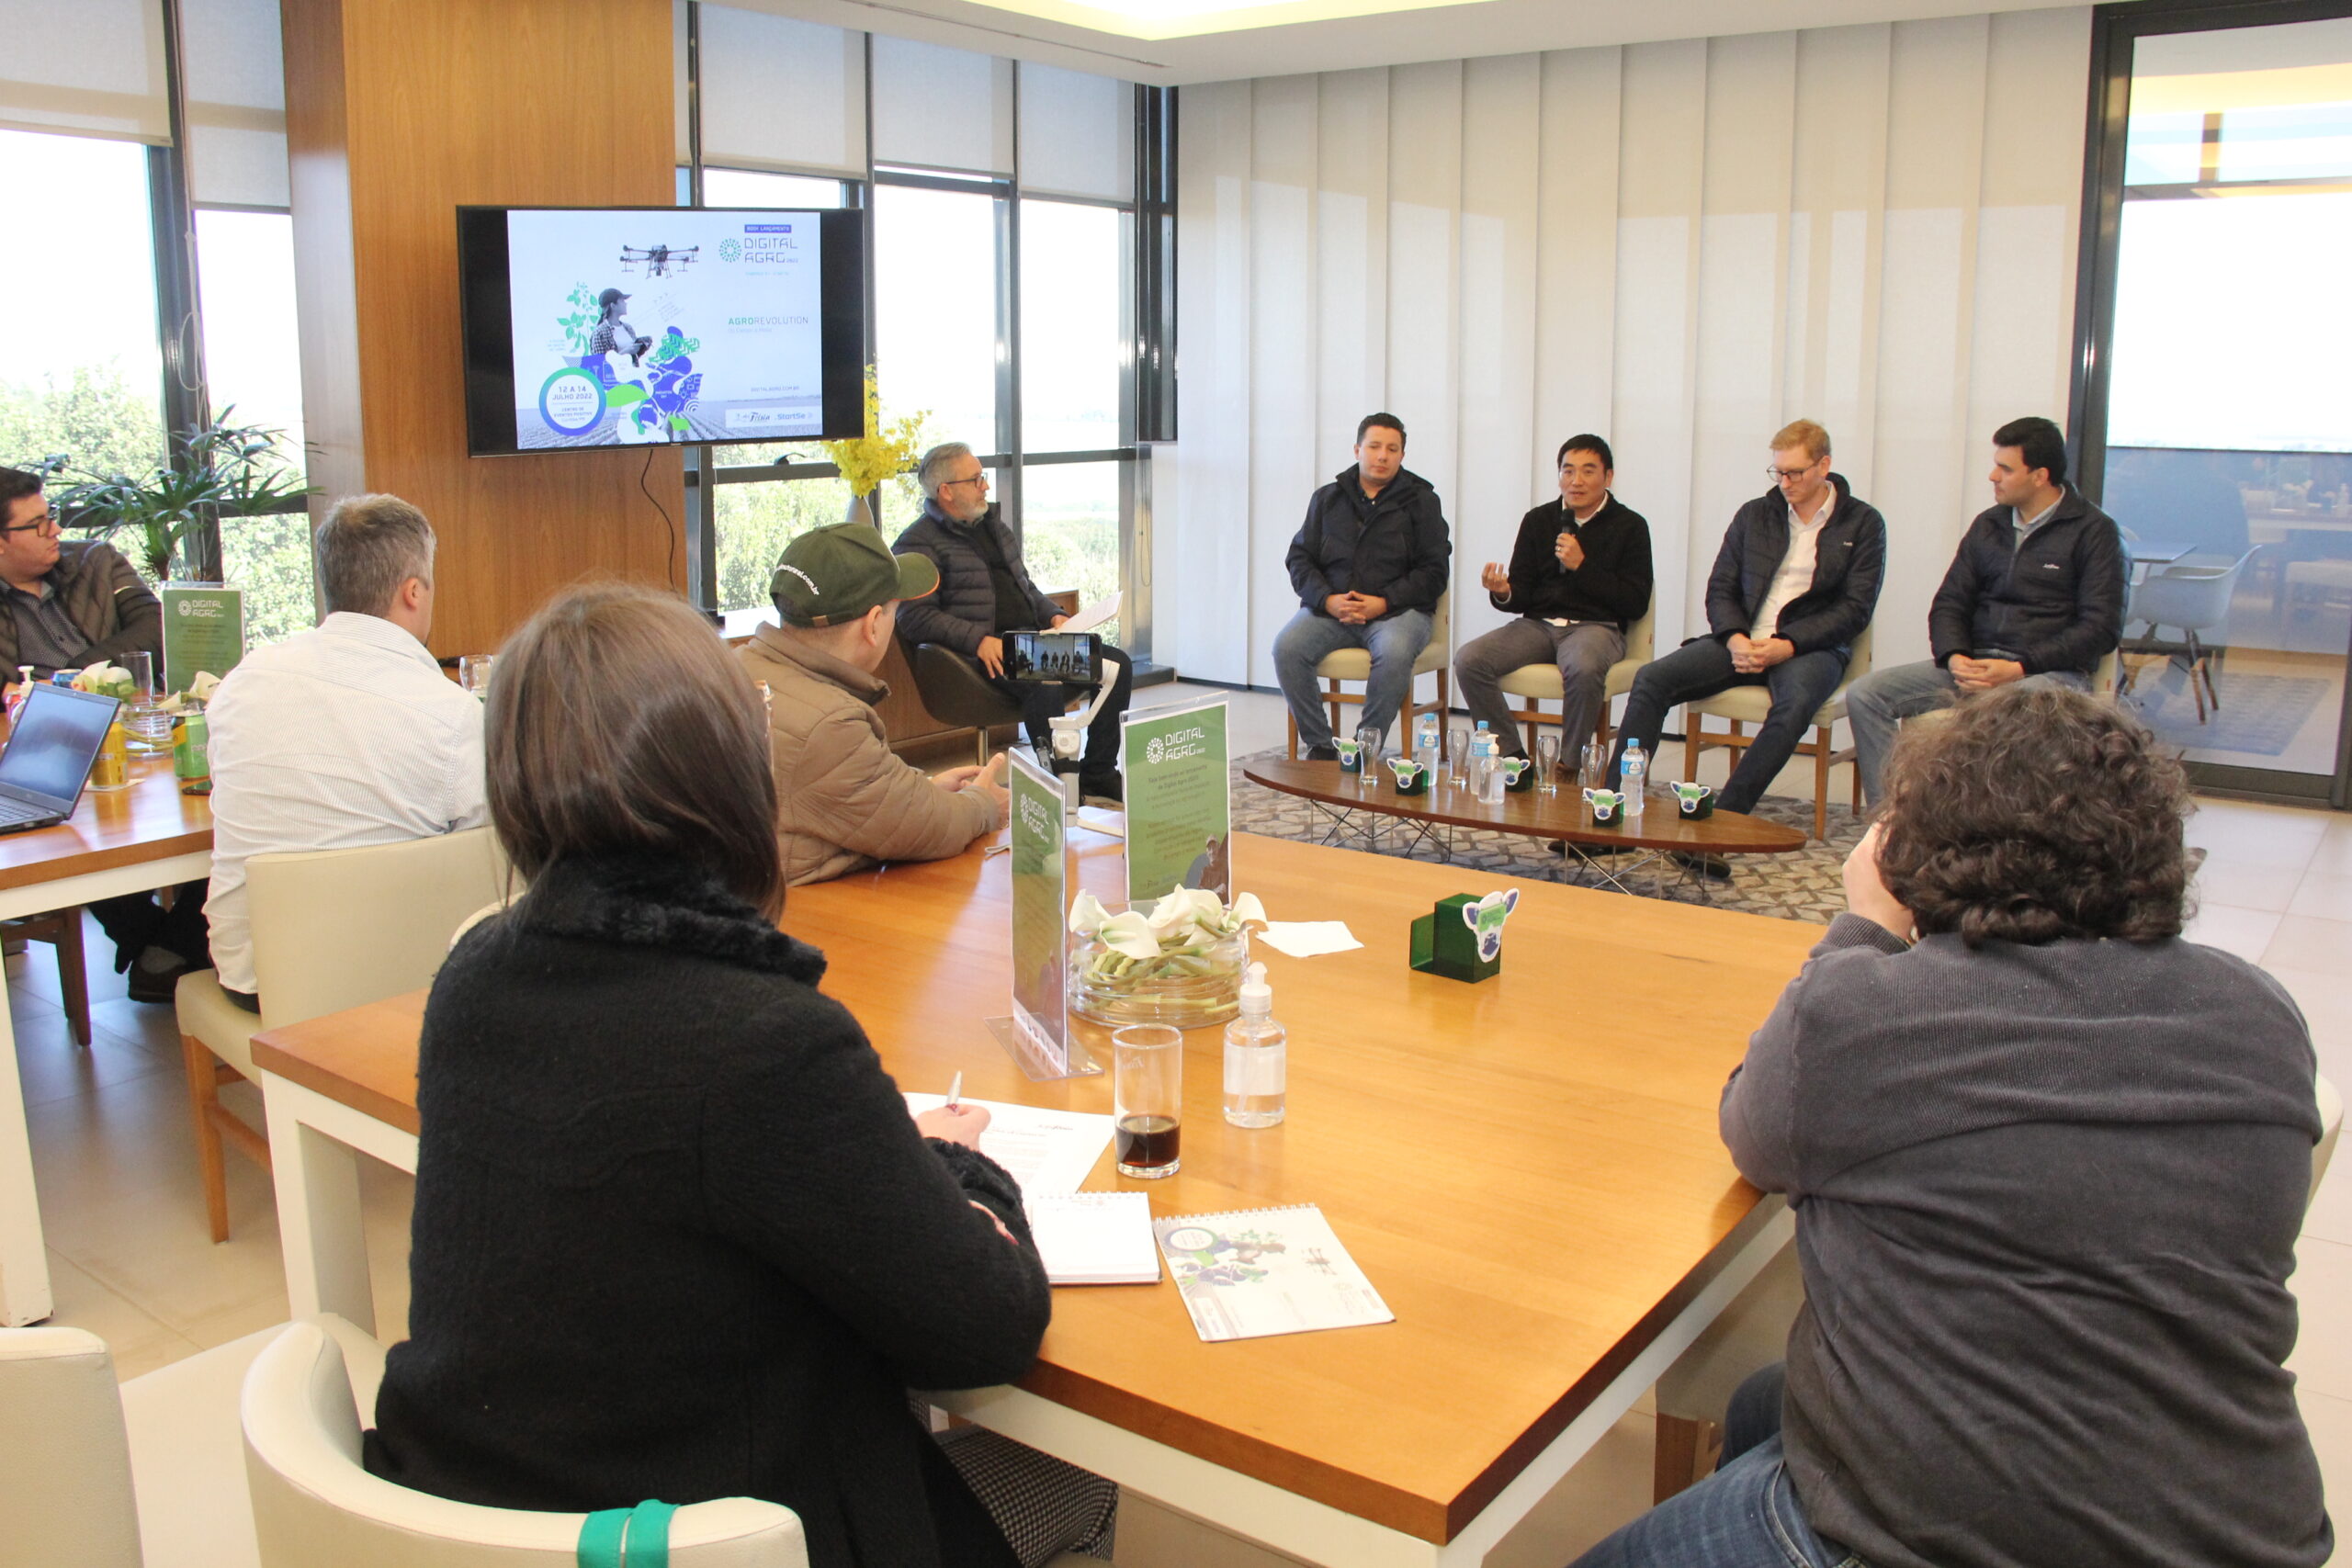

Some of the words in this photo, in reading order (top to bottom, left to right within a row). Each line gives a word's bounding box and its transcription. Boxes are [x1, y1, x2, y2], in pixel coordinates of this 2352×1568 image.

[744, 238, 798, 249] DIGITAL
[192, 600, 224, 608] DIGITAL
[1165, 727, 1205, 746] DIGITAL
